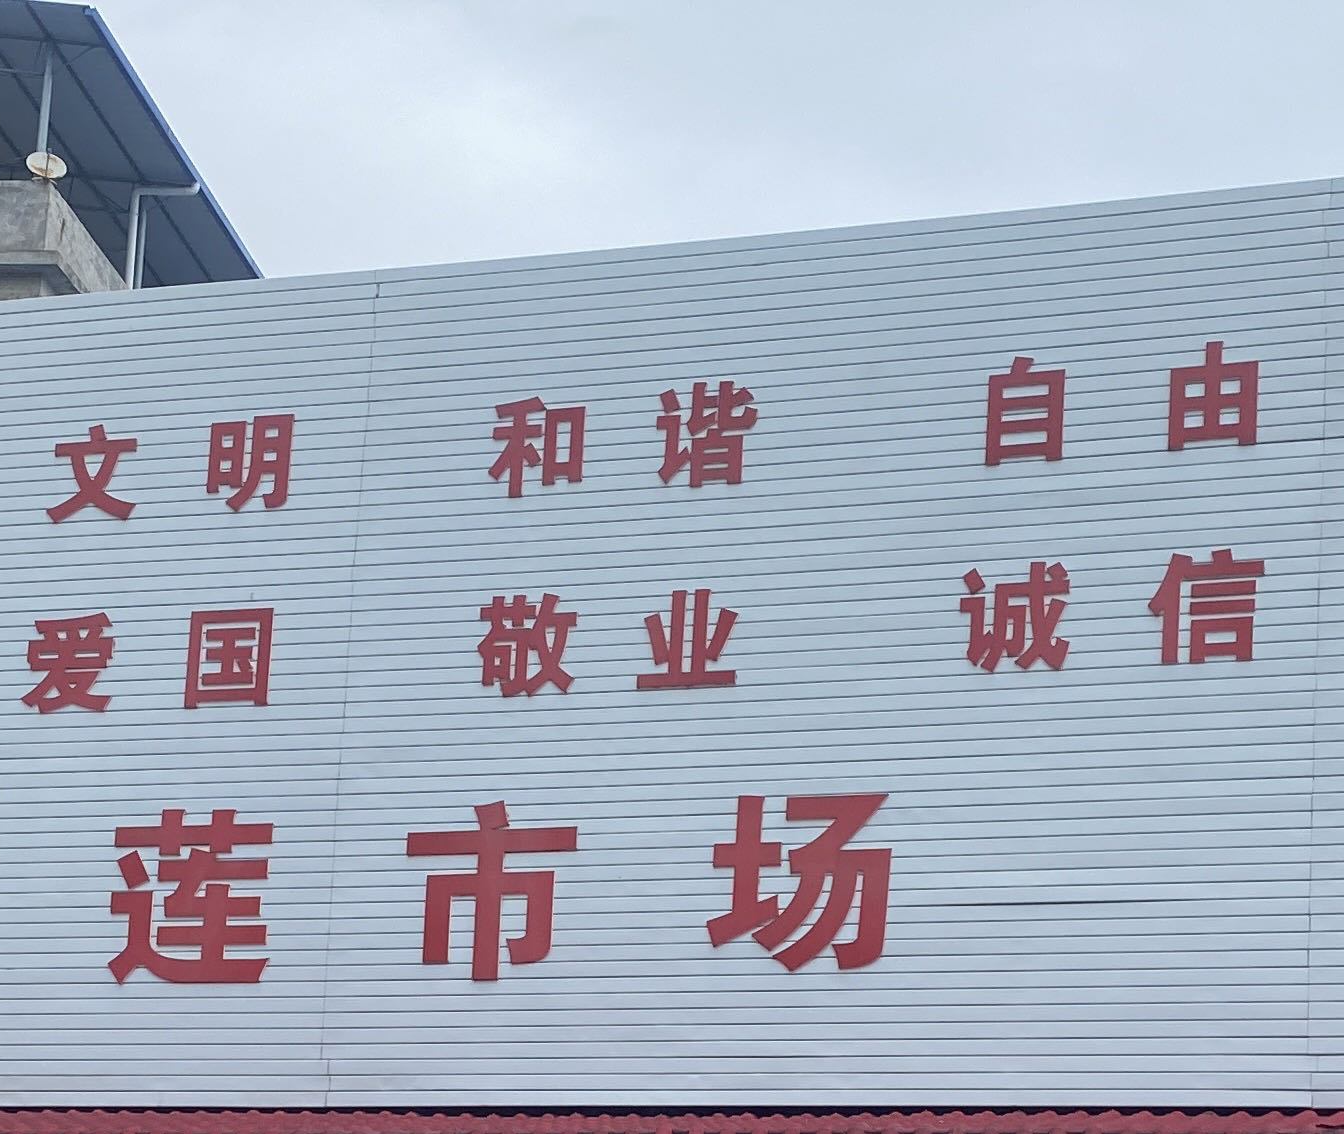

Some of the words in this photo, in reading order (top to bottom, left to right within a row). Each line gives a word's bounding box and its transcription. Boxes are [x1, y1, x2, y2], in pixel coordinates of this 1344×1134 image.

[46, 412, 294, 524] 文明
[489, 381, 758, 497] 和谐
[985, 341, 1262, 464] 自由
[21, 607, 275, 714] 爱国
[476, 587, 741, 697] 敬业
[959, 549, 1268, 672] 诚信
